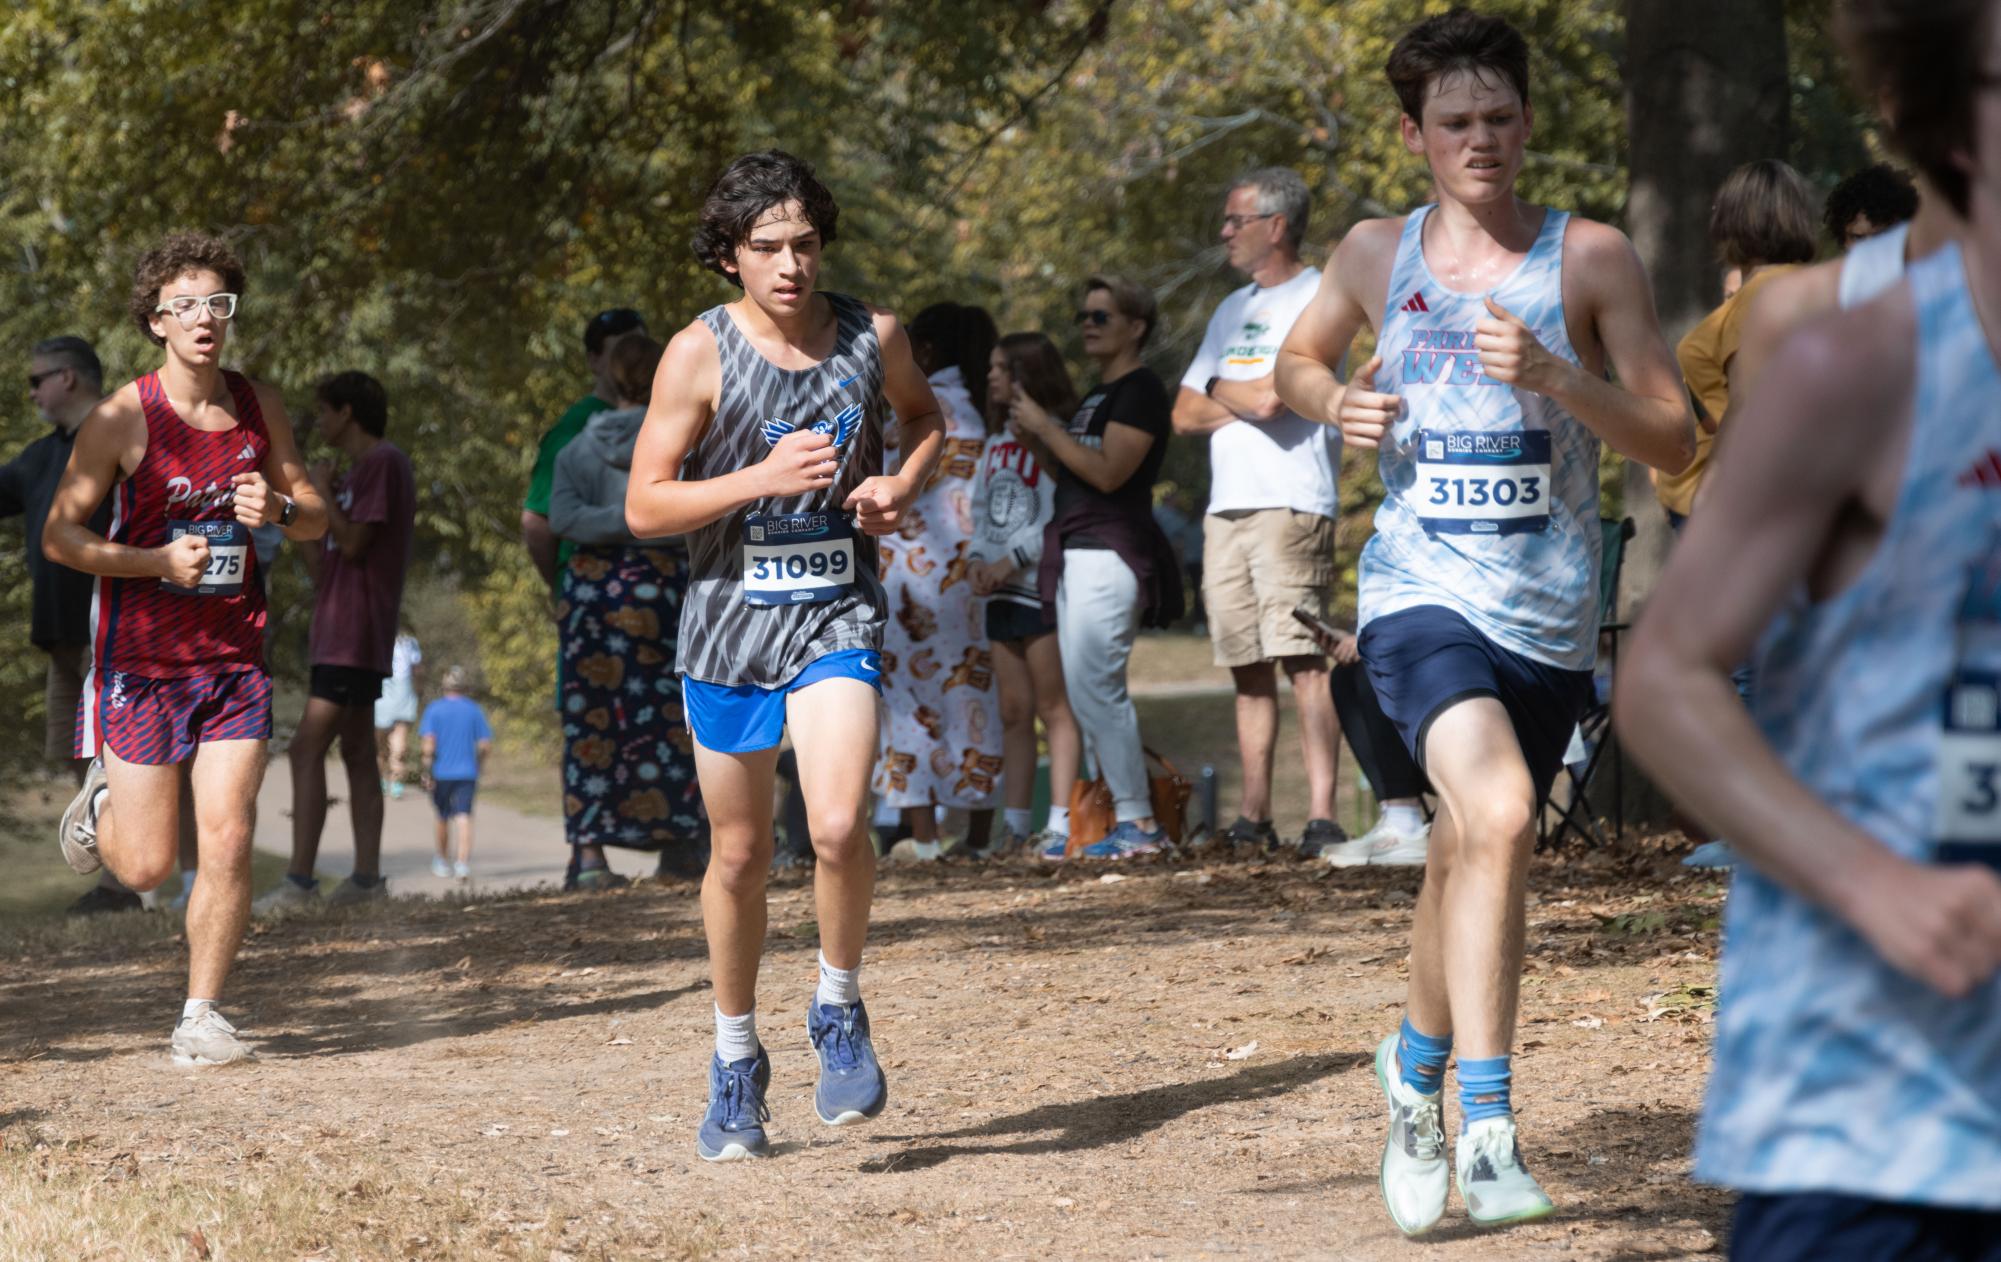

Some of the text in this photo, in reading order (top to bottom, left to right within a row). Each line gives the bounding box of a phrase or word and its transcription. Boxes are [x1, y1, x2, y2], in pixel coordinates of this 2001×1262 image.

[1447, 435, 1520, 449] BIG RIVER
[1428, 477, 1540, 506] 31303
[188, 525, 233, 535] BIG RIVER
[767, 520, 789, 532] BIG
[791, 515, 828, 529] RIVER
[203, 555, 239, 576] 275
[752, 550, 848, 580] 31099
